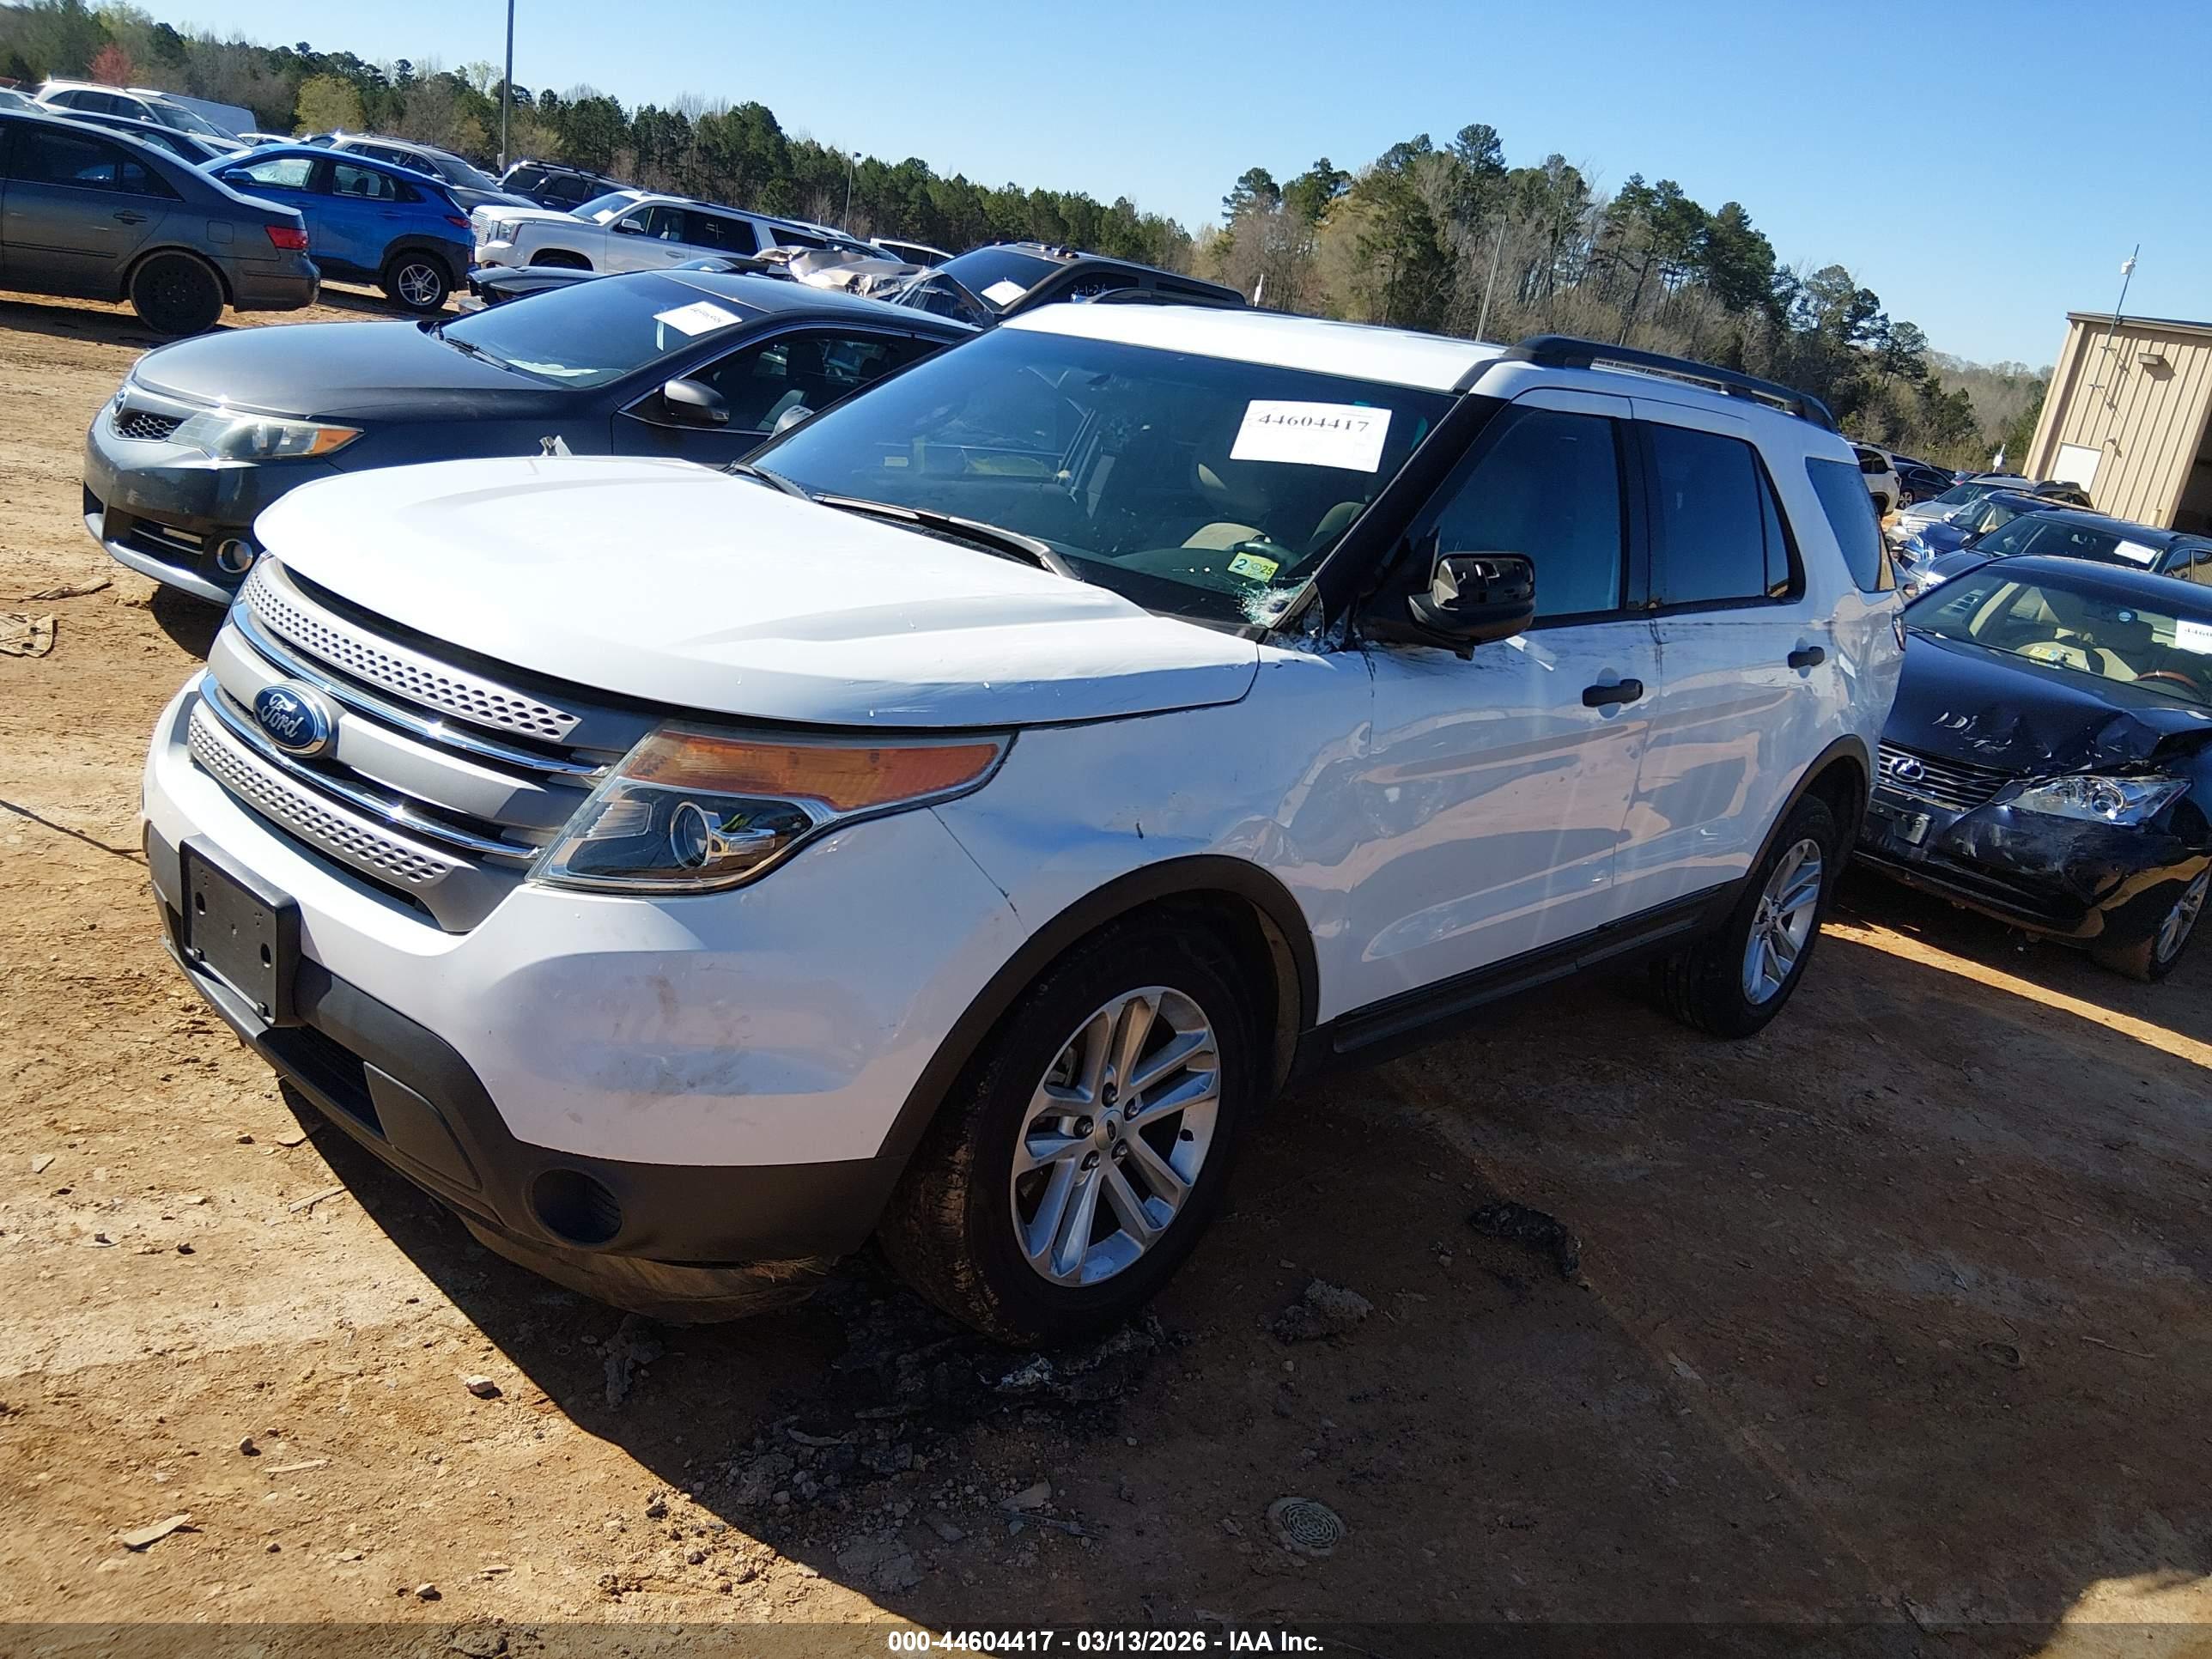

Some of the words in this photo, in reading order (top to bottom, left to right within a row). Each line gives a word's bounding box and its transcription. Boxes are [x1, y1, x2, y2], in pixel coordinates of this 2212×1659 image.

[1258, 413, 1370, 432] 44604417
[1234, 558, 1248, 570] 2
[1260, 565, 1275, 575] 25
[261, 693, 304, 738] Ford
